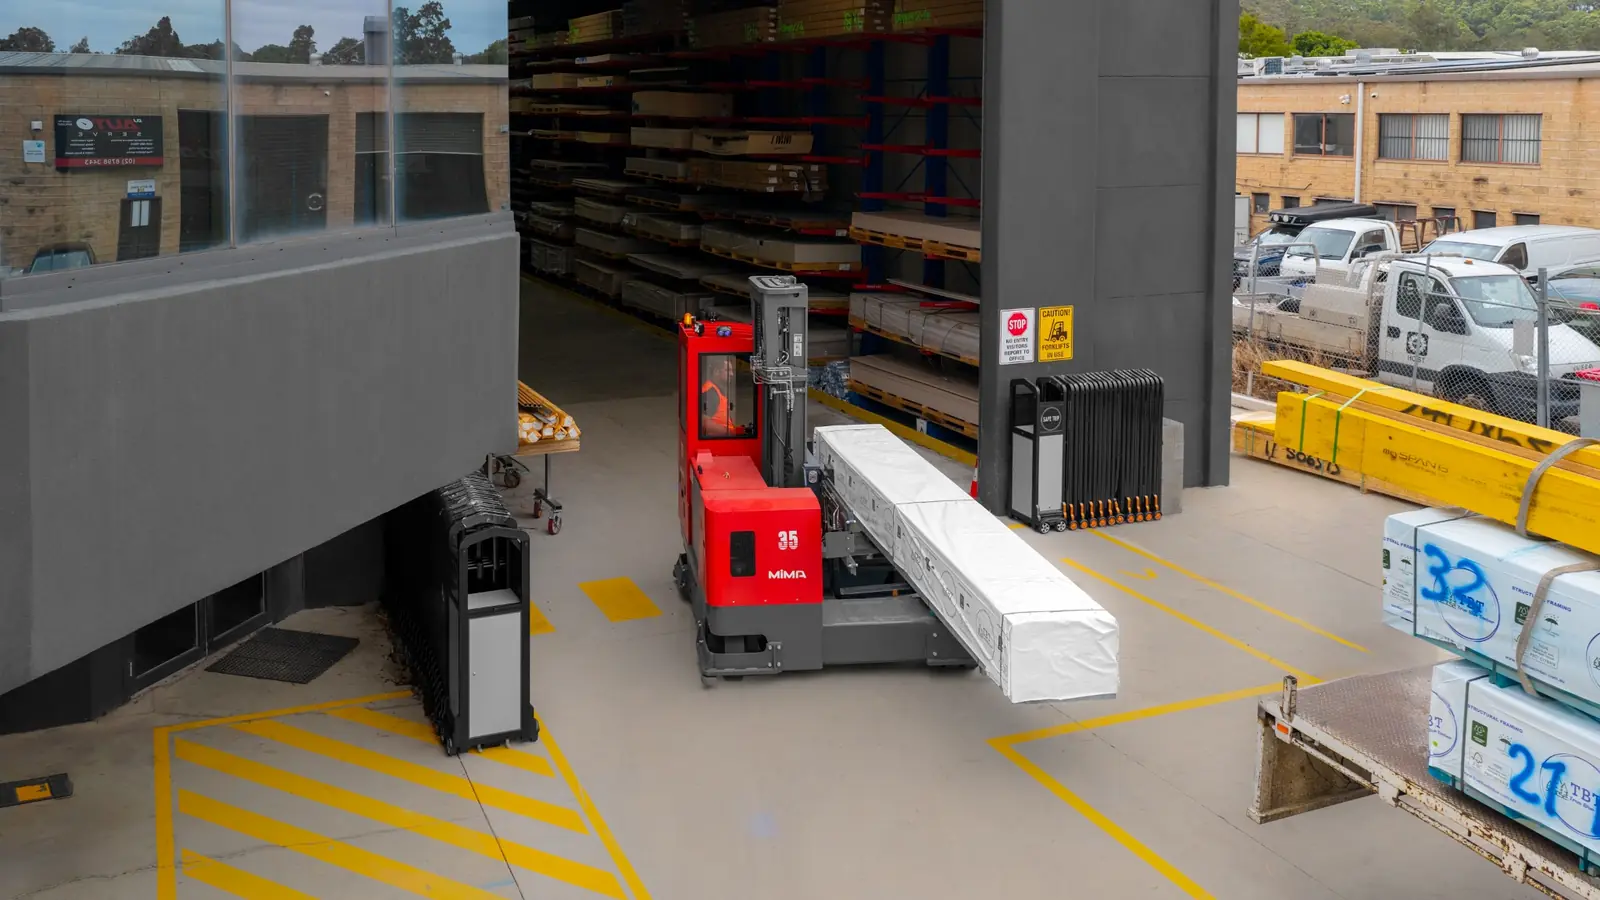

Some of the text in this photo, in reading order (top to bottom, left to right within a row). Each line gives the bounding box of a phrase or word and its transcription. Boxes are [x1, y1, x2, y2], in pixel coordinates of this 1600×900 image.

[1042, 309, 1071, 318] CAUTION!
[1009, 319, 1027, 330] STOP
[1042, 343, 1070, 351] FORKLIFTS
[1407, 355, 1425, 363] HOST
[778, 530, 798, 550] 35
[1400, 542, 1421, 553] FRAMIG
[1547, 599, 1572, 613] FRAMING
[1500, 720, 1524, 734] FRAMING
